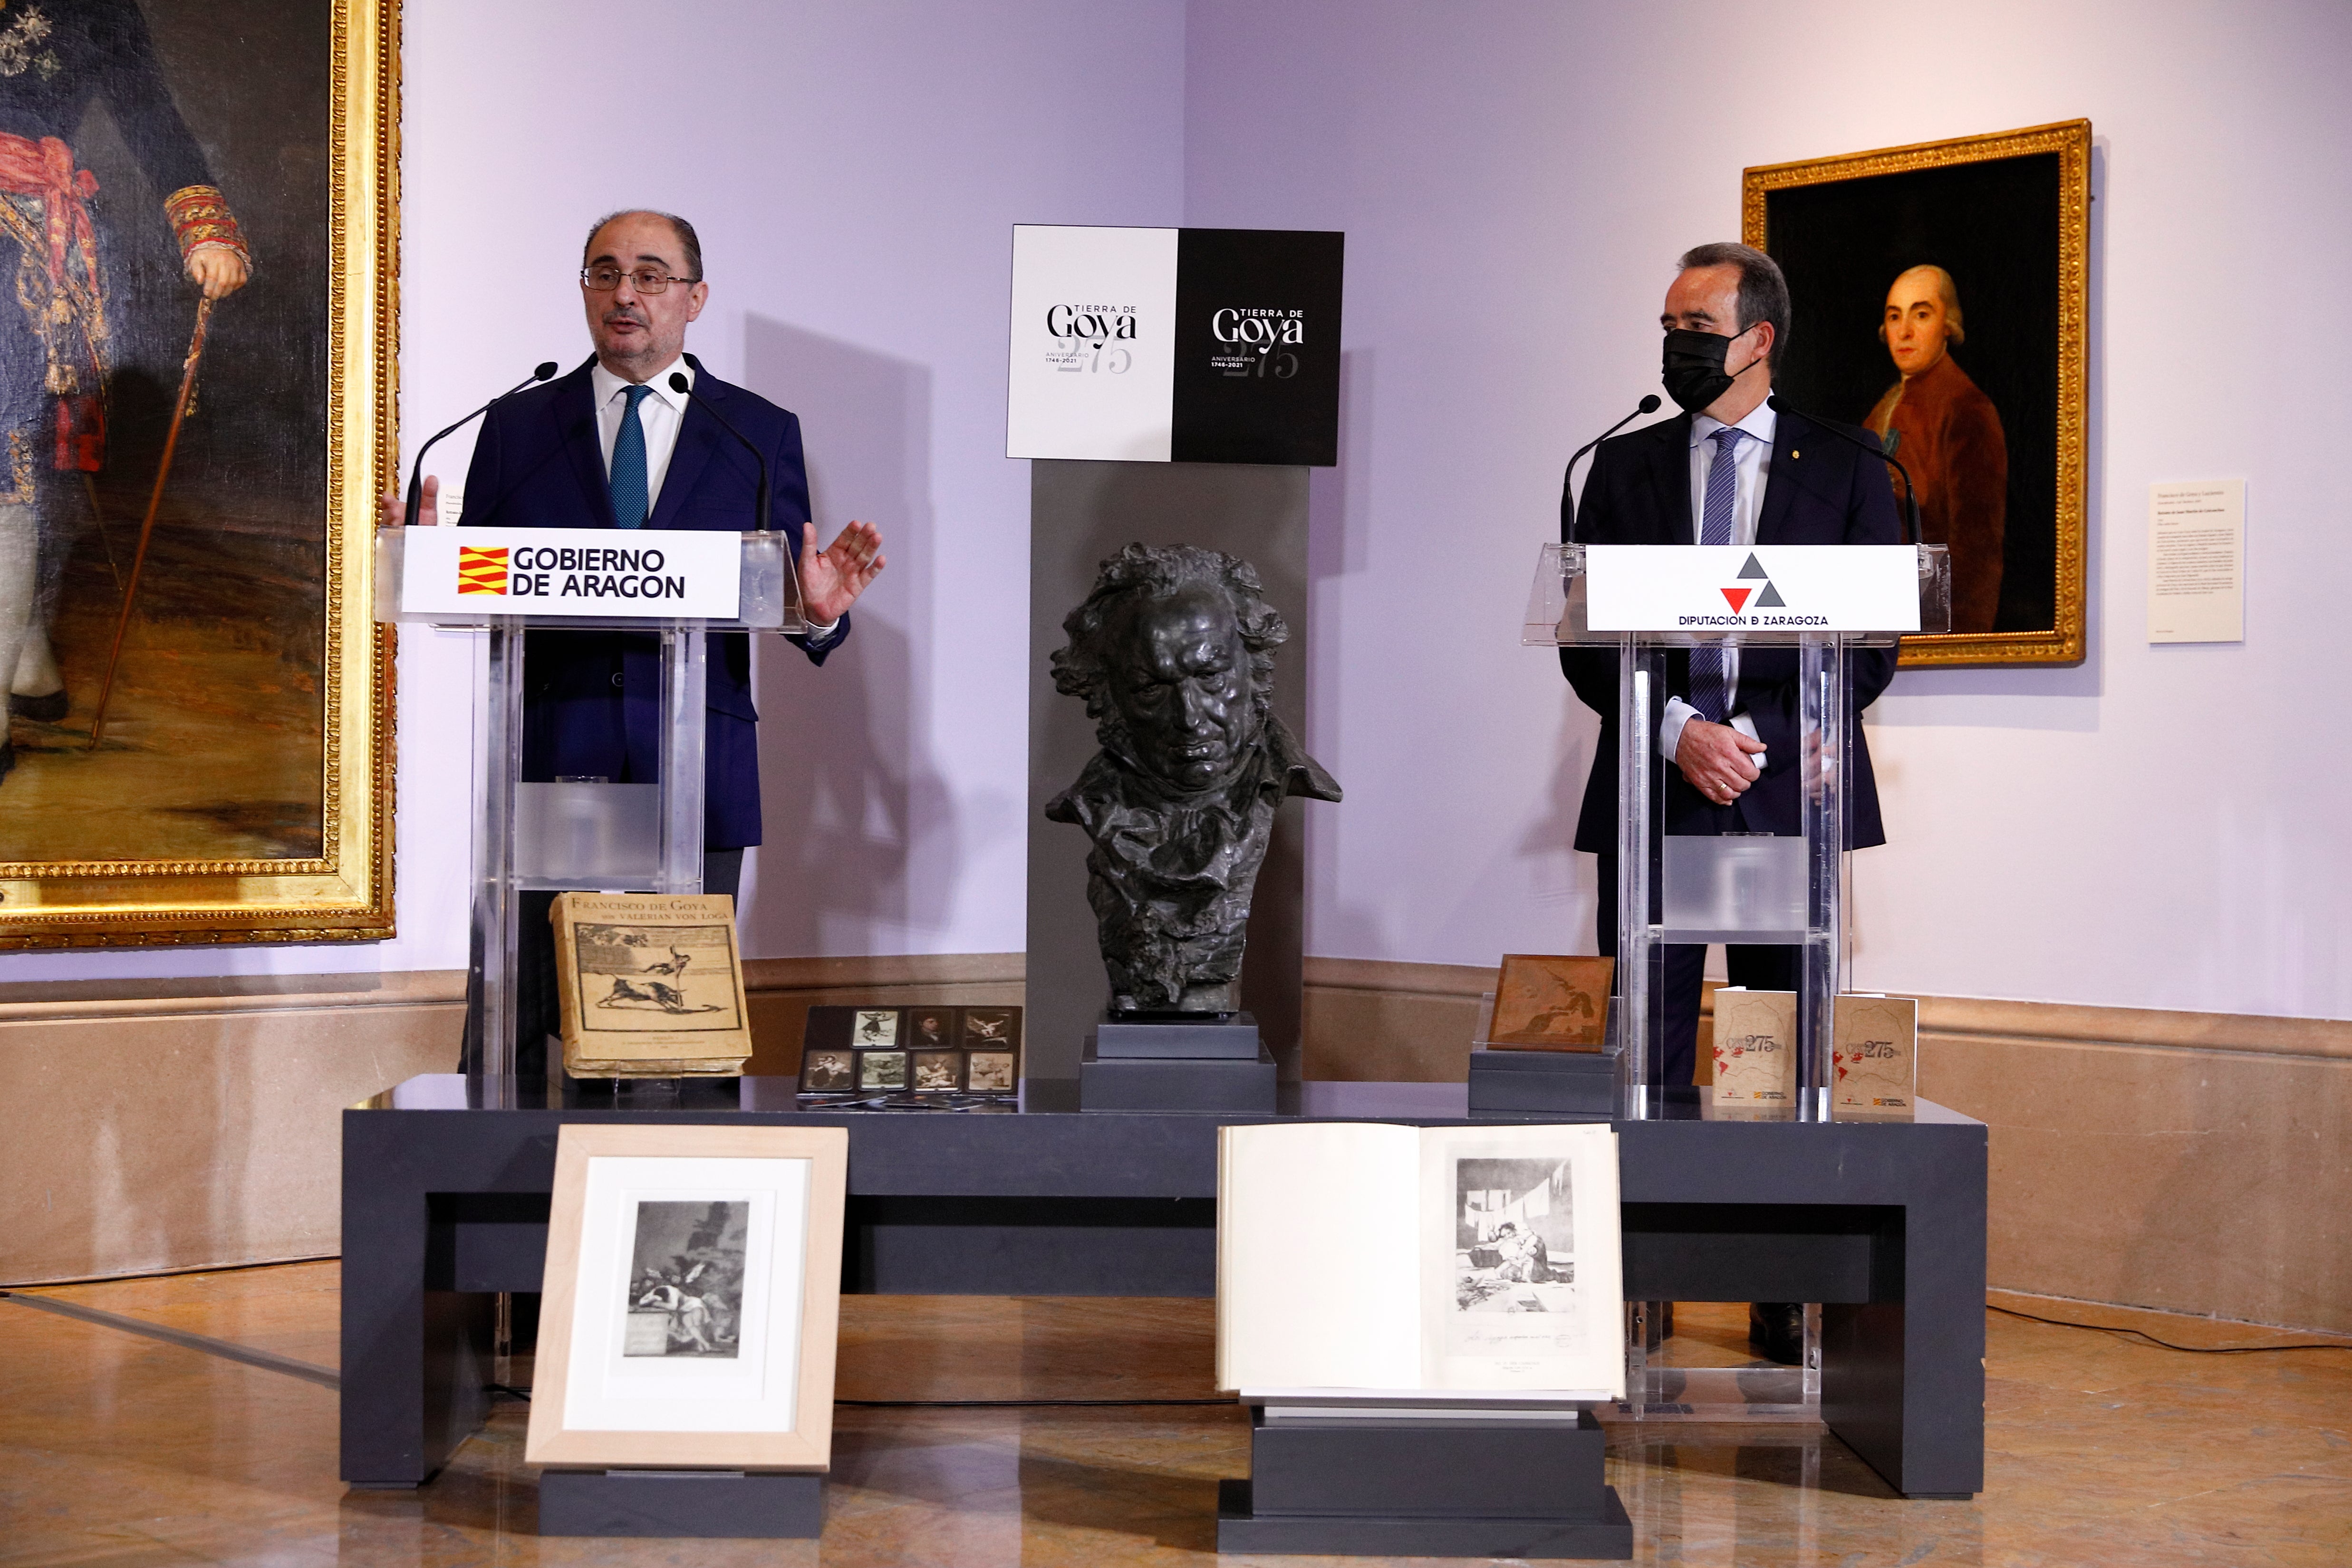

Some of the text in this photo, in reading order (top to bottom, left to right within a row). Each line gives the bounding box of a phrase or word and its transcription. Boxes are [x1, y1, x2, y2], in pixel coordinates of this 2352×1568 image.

[1240, 308, 1283, 317] TIERRA
[1047, 304, 1137, 349] Goya
[1212, 308, 1303, 354] Goya
[1057, 334, 1132, 374] 275
[514, 547, 665, 572] GOBIERNO
[512, 574, 685, 598] DE ARAGON
[1679, 616, 1746, 625] DIPUTACION
[1764, 616, 1829, 625] ZARAGOZA
[1745, 1035, 1774, 1052] 275
[1864, 1040, 1893, 1058] 275
